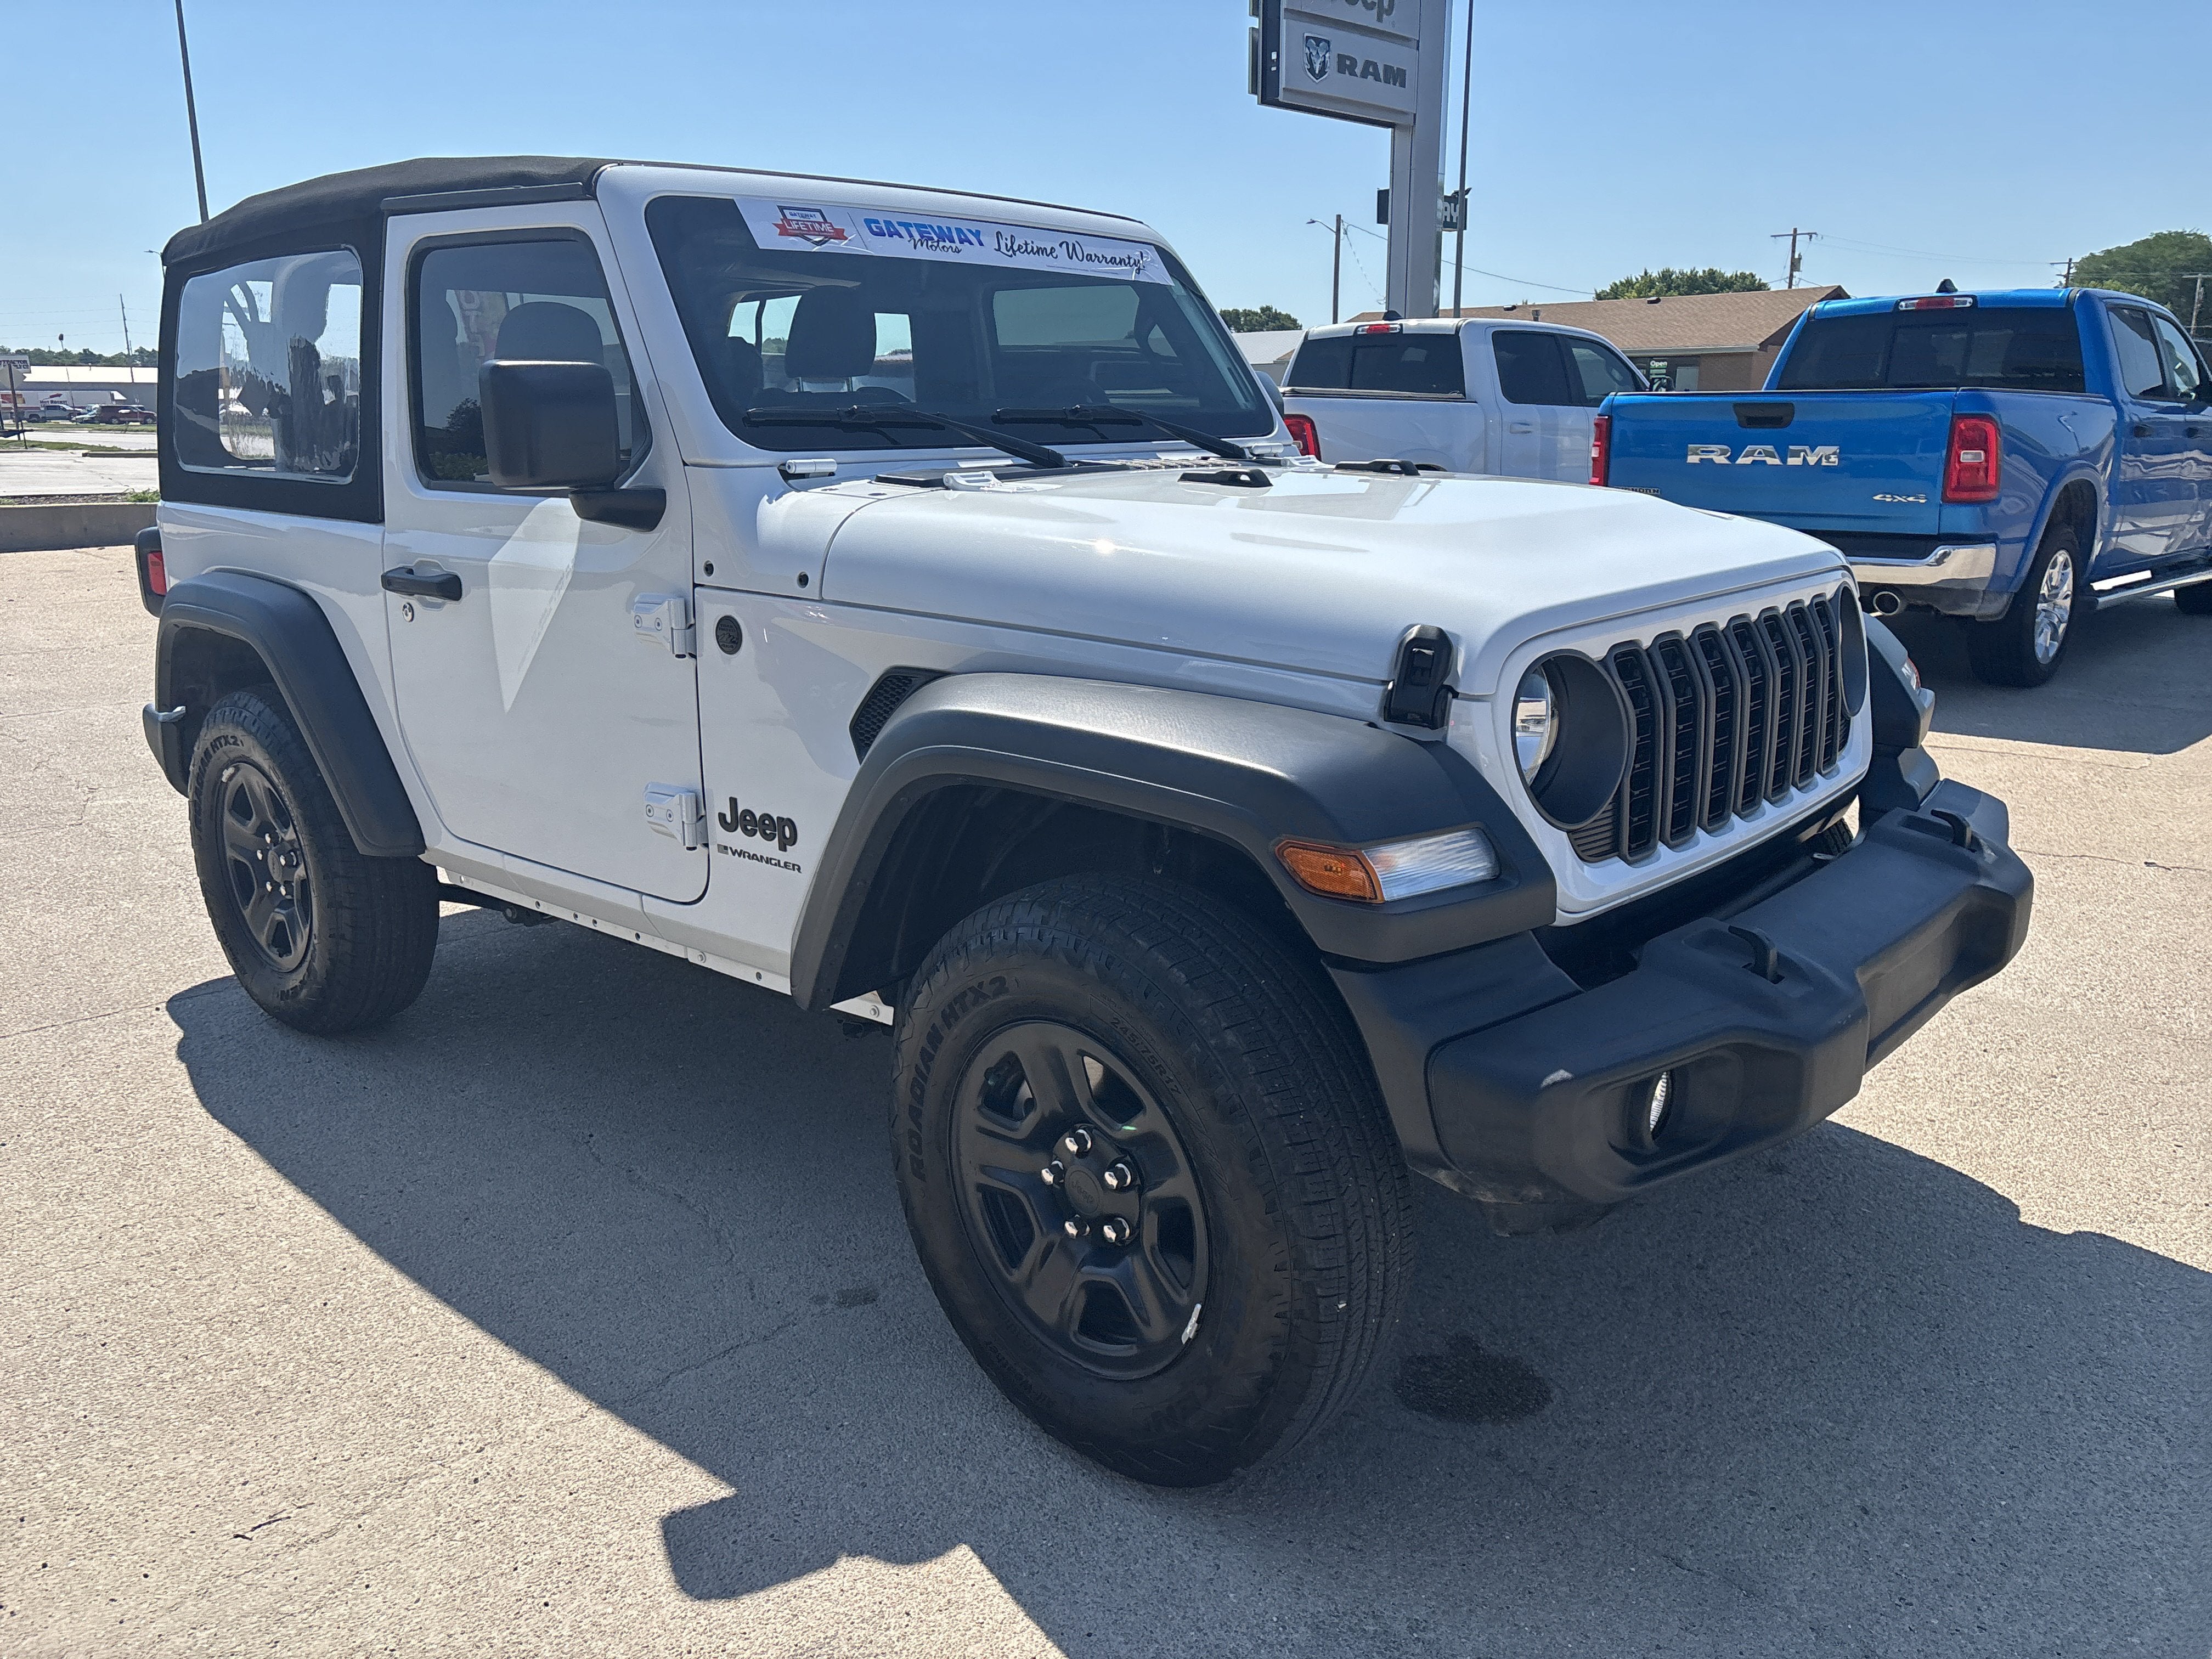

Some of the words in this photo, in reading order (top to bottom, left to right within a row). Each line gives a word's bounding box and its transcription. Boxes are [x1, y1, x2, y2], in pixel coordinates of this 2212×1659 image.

[1337, 53, 1407, 88] RAM
[783, 219, 834, 233] LIFETIME
[864, 218, 985, 247] GATEWAY
[907, 238, 962, 254] Motors
[994, 230, 1058, 259] Lifetime
[1059, 240, 1146, 274] Warranty!
[1686, 444, 1840, 466] RAM
[1872, 494, 1928, 503] 4x4
[718, 796, 798, 853] Jeep
[729, 846, 802, 874] WRANGLER
[908, 1023, 944, 1183] ROADIAN
